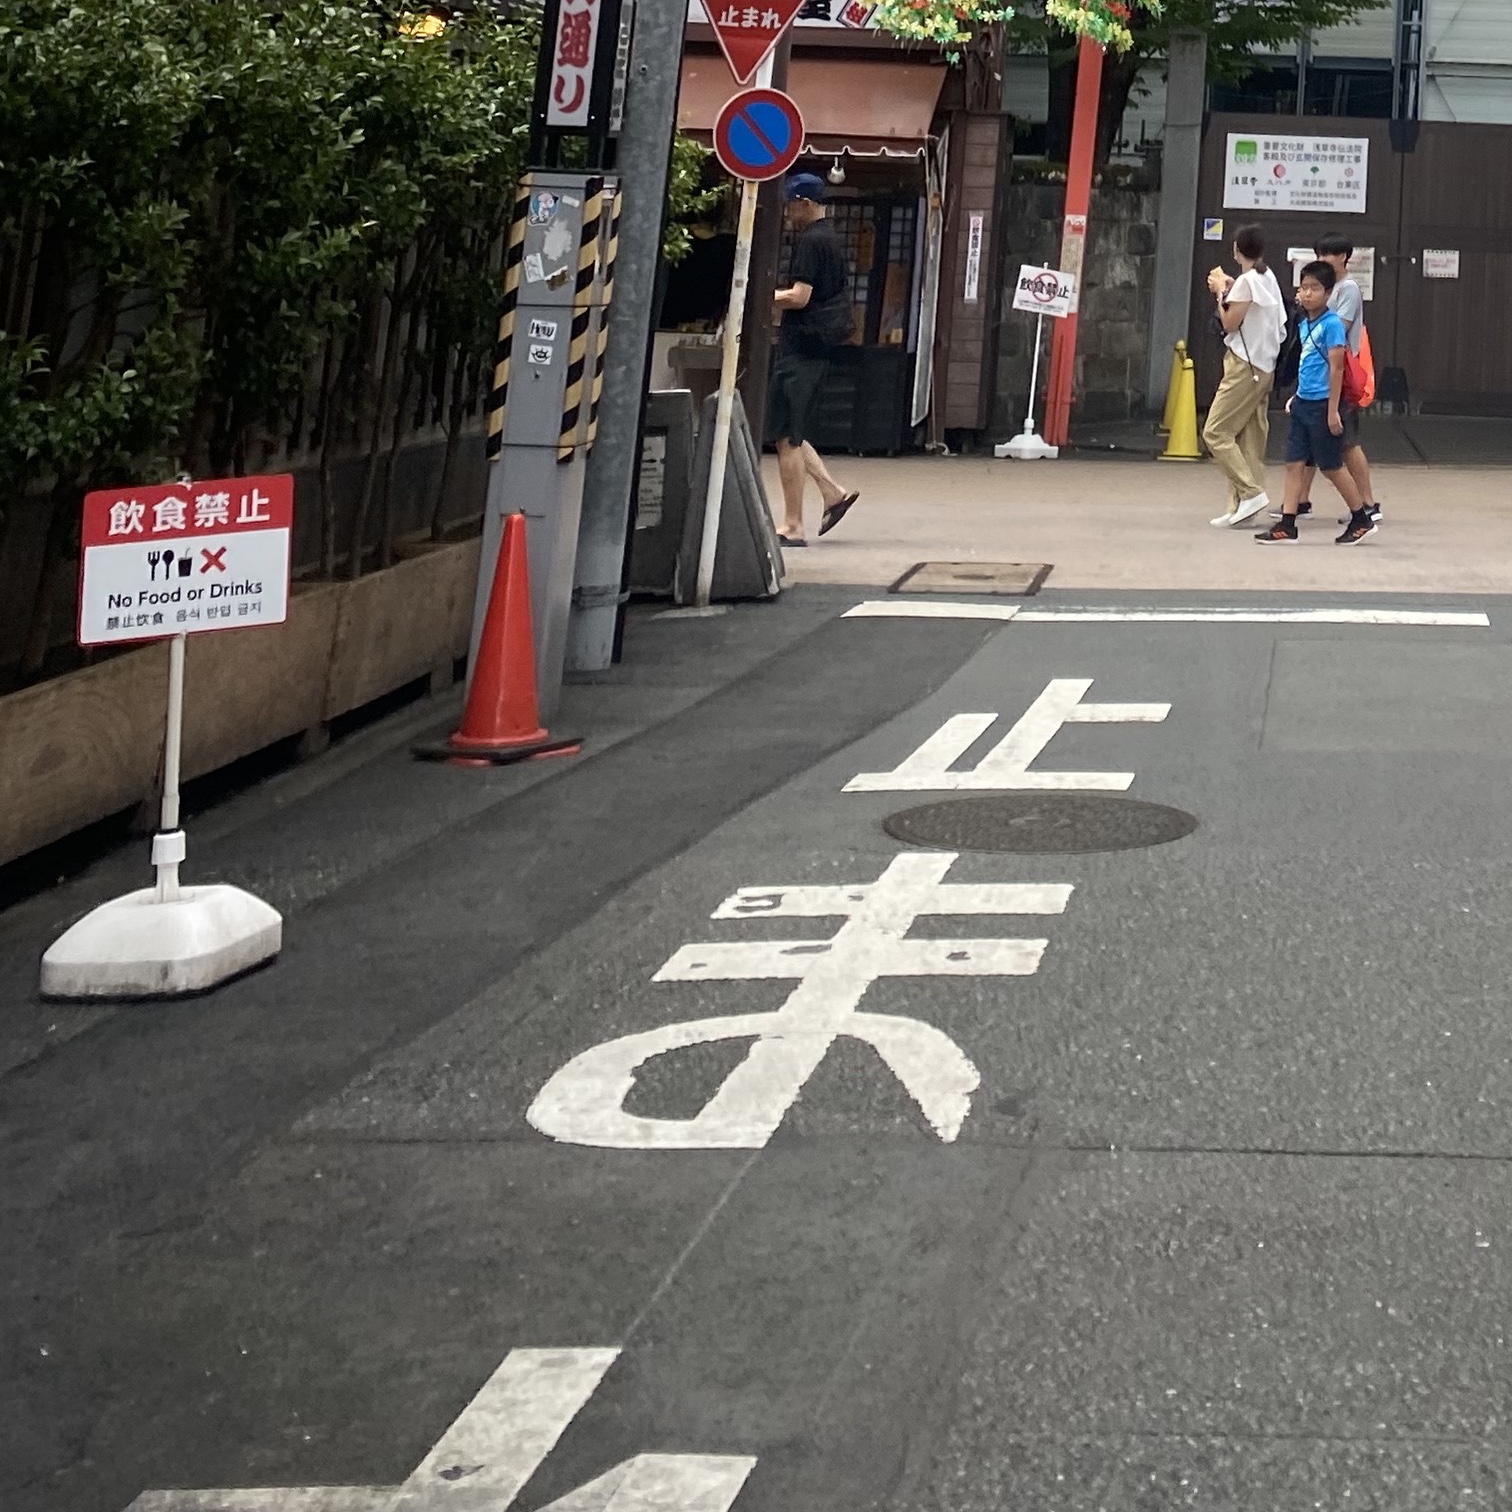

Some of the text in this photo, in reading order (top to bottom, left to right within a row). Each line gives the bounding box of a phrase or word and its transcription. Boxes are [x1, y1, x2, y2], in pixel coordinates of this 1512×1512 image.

[717, 4, 783, 30] 止まれ
[1019, 277, 1070, 300] 飲食禁止
[108, 488, 271, 537] 飲食禁止
[107, 579, 263, 610] No Food or Drinks
[175, 600, 262, 623] 음식 반입 금지
